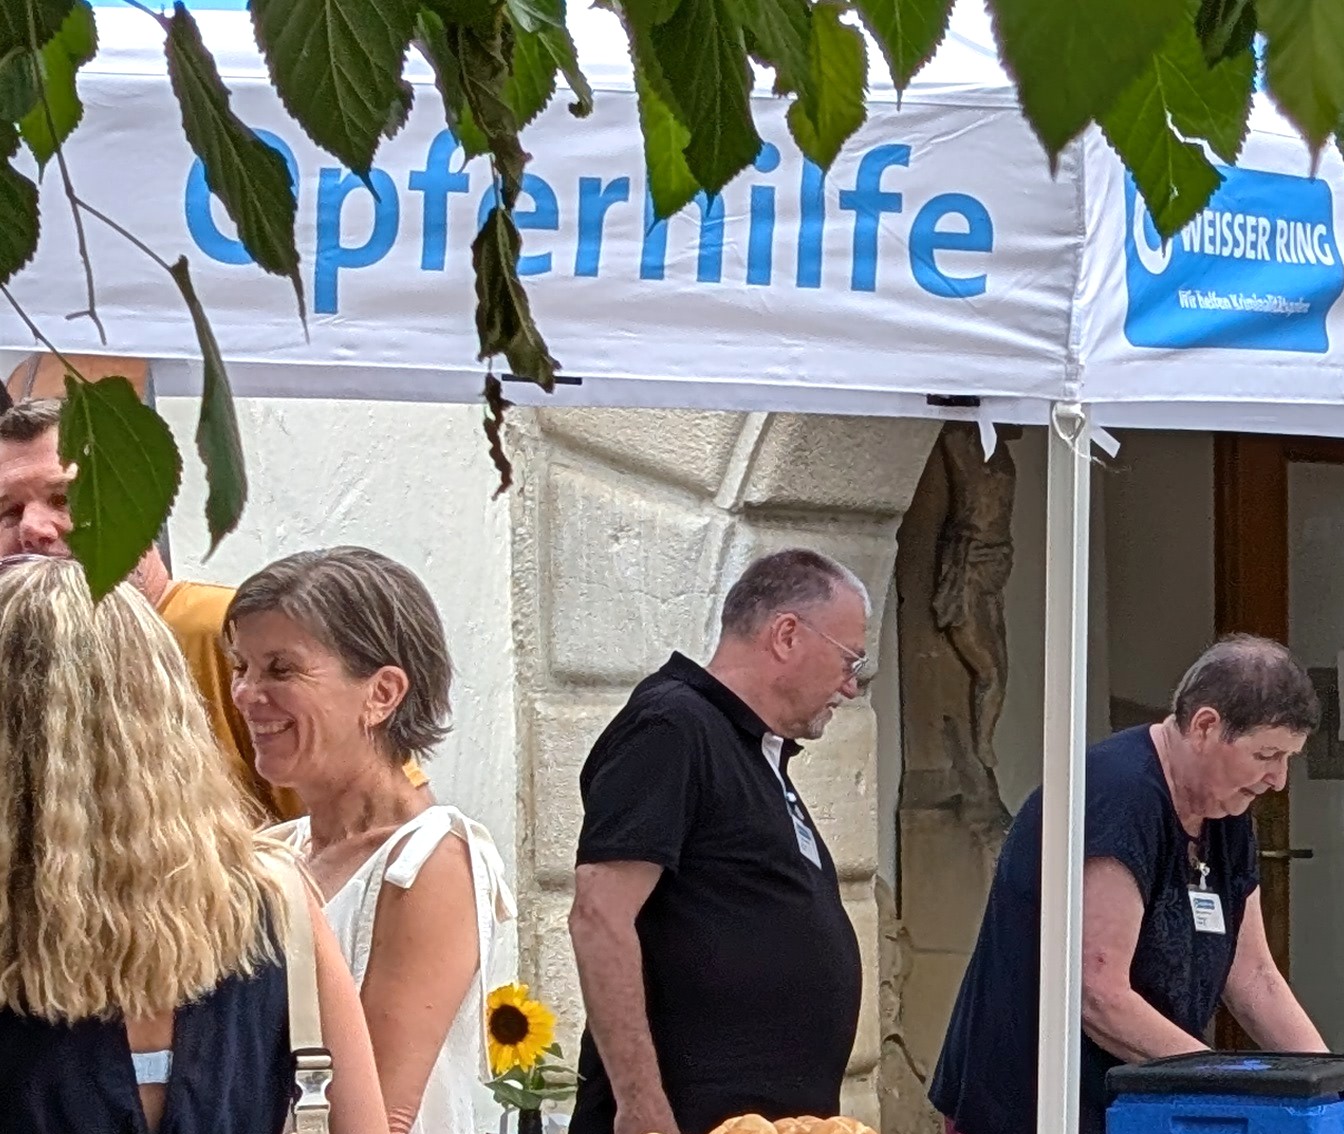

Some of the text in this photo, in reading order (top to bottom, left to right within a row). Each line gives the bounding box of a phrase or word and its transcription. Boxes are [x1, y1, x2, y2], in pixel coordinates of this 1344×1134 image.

[1181, 210, 1335, 266] WEISSER RING
[1178, 289, 1197, 309] Wir
